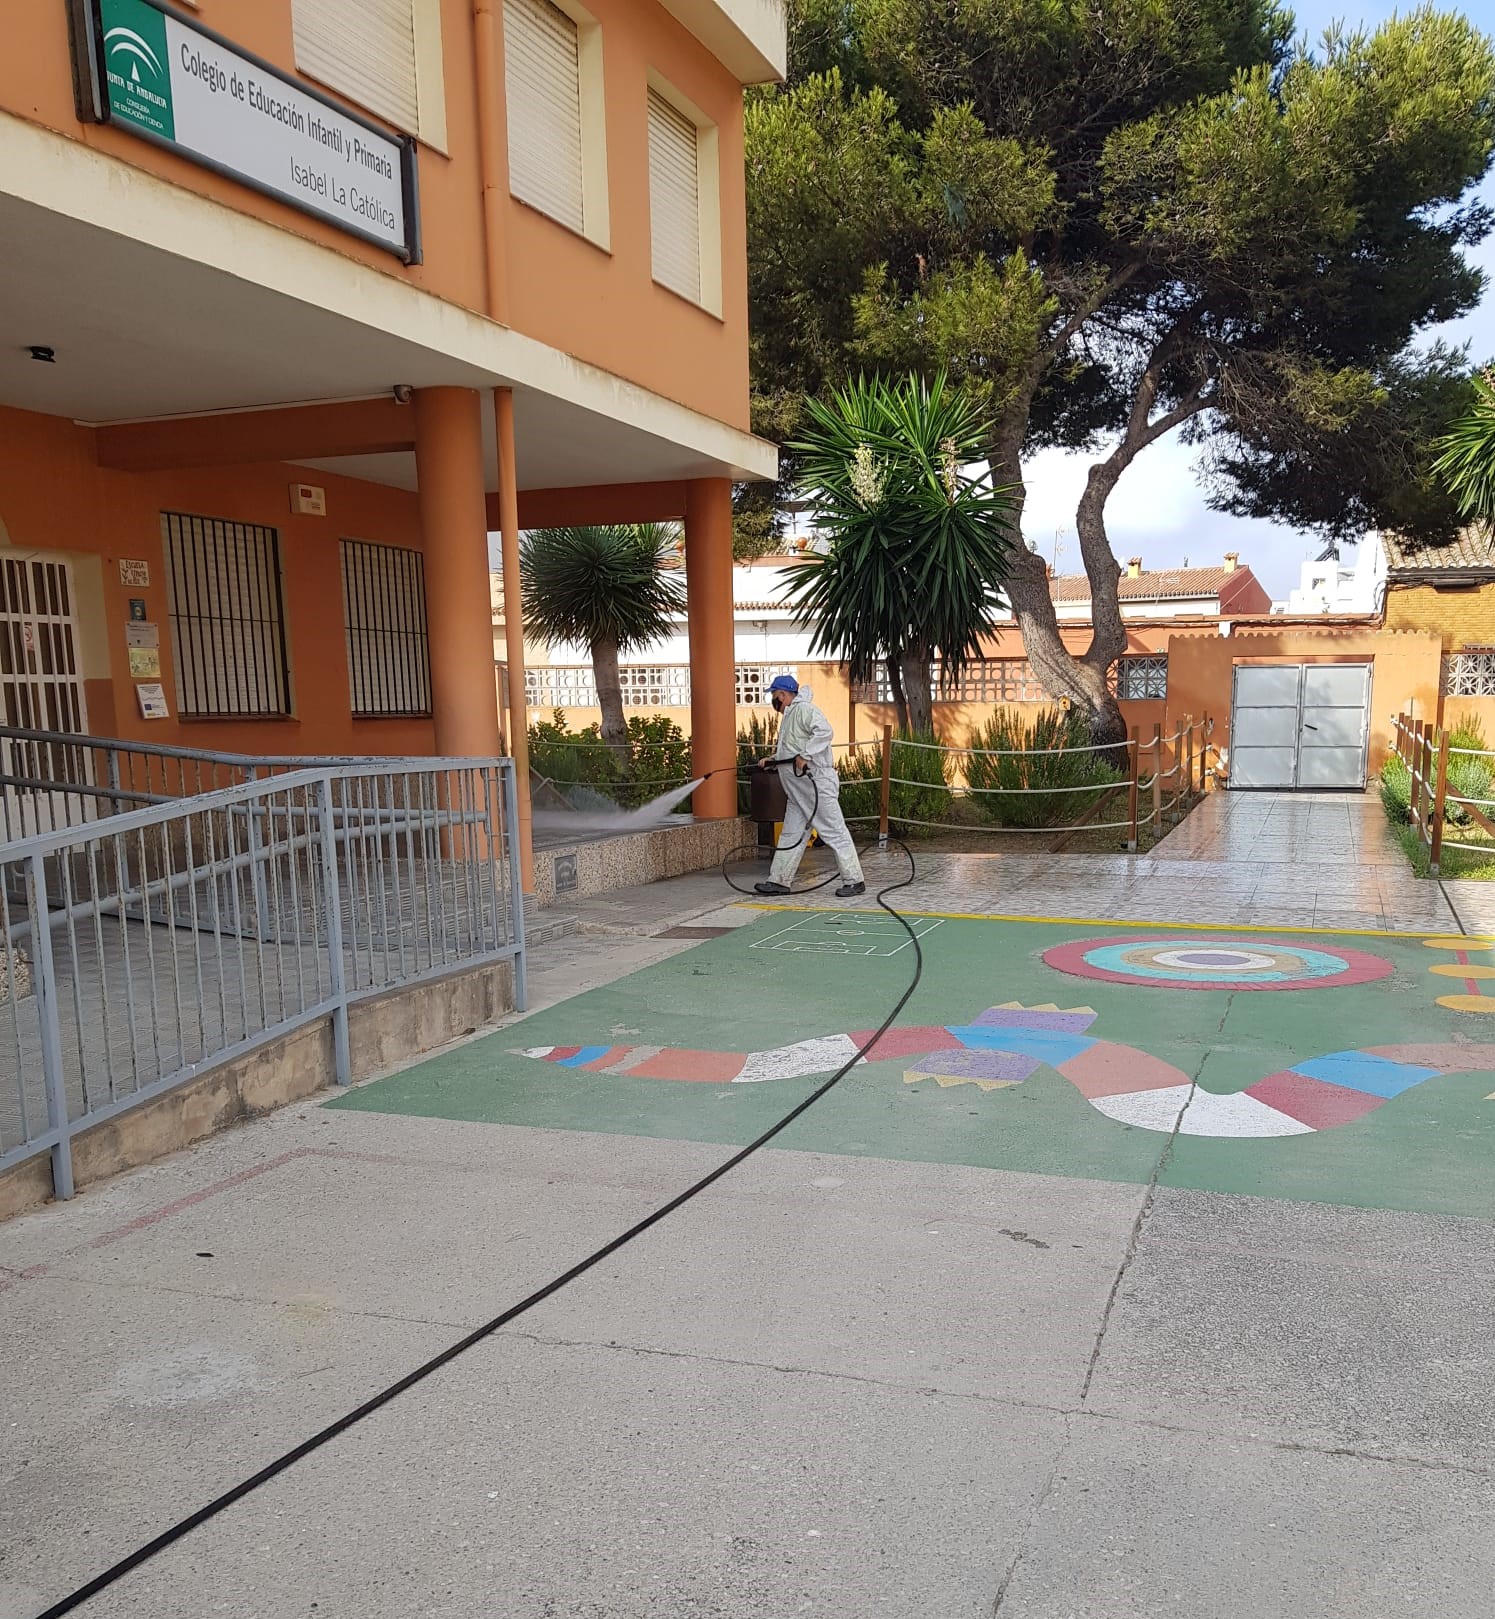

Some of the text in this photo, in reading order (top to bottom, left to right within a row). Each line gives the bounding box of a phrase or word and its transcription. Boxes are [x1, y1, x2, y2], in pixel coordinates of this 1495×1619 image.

[126, 80, 135, 93] DE
[181, 43, 393, 180] Colegio de Educación Infantil y Primaria
[290, 155, 395, 231] Isabel La Católica
